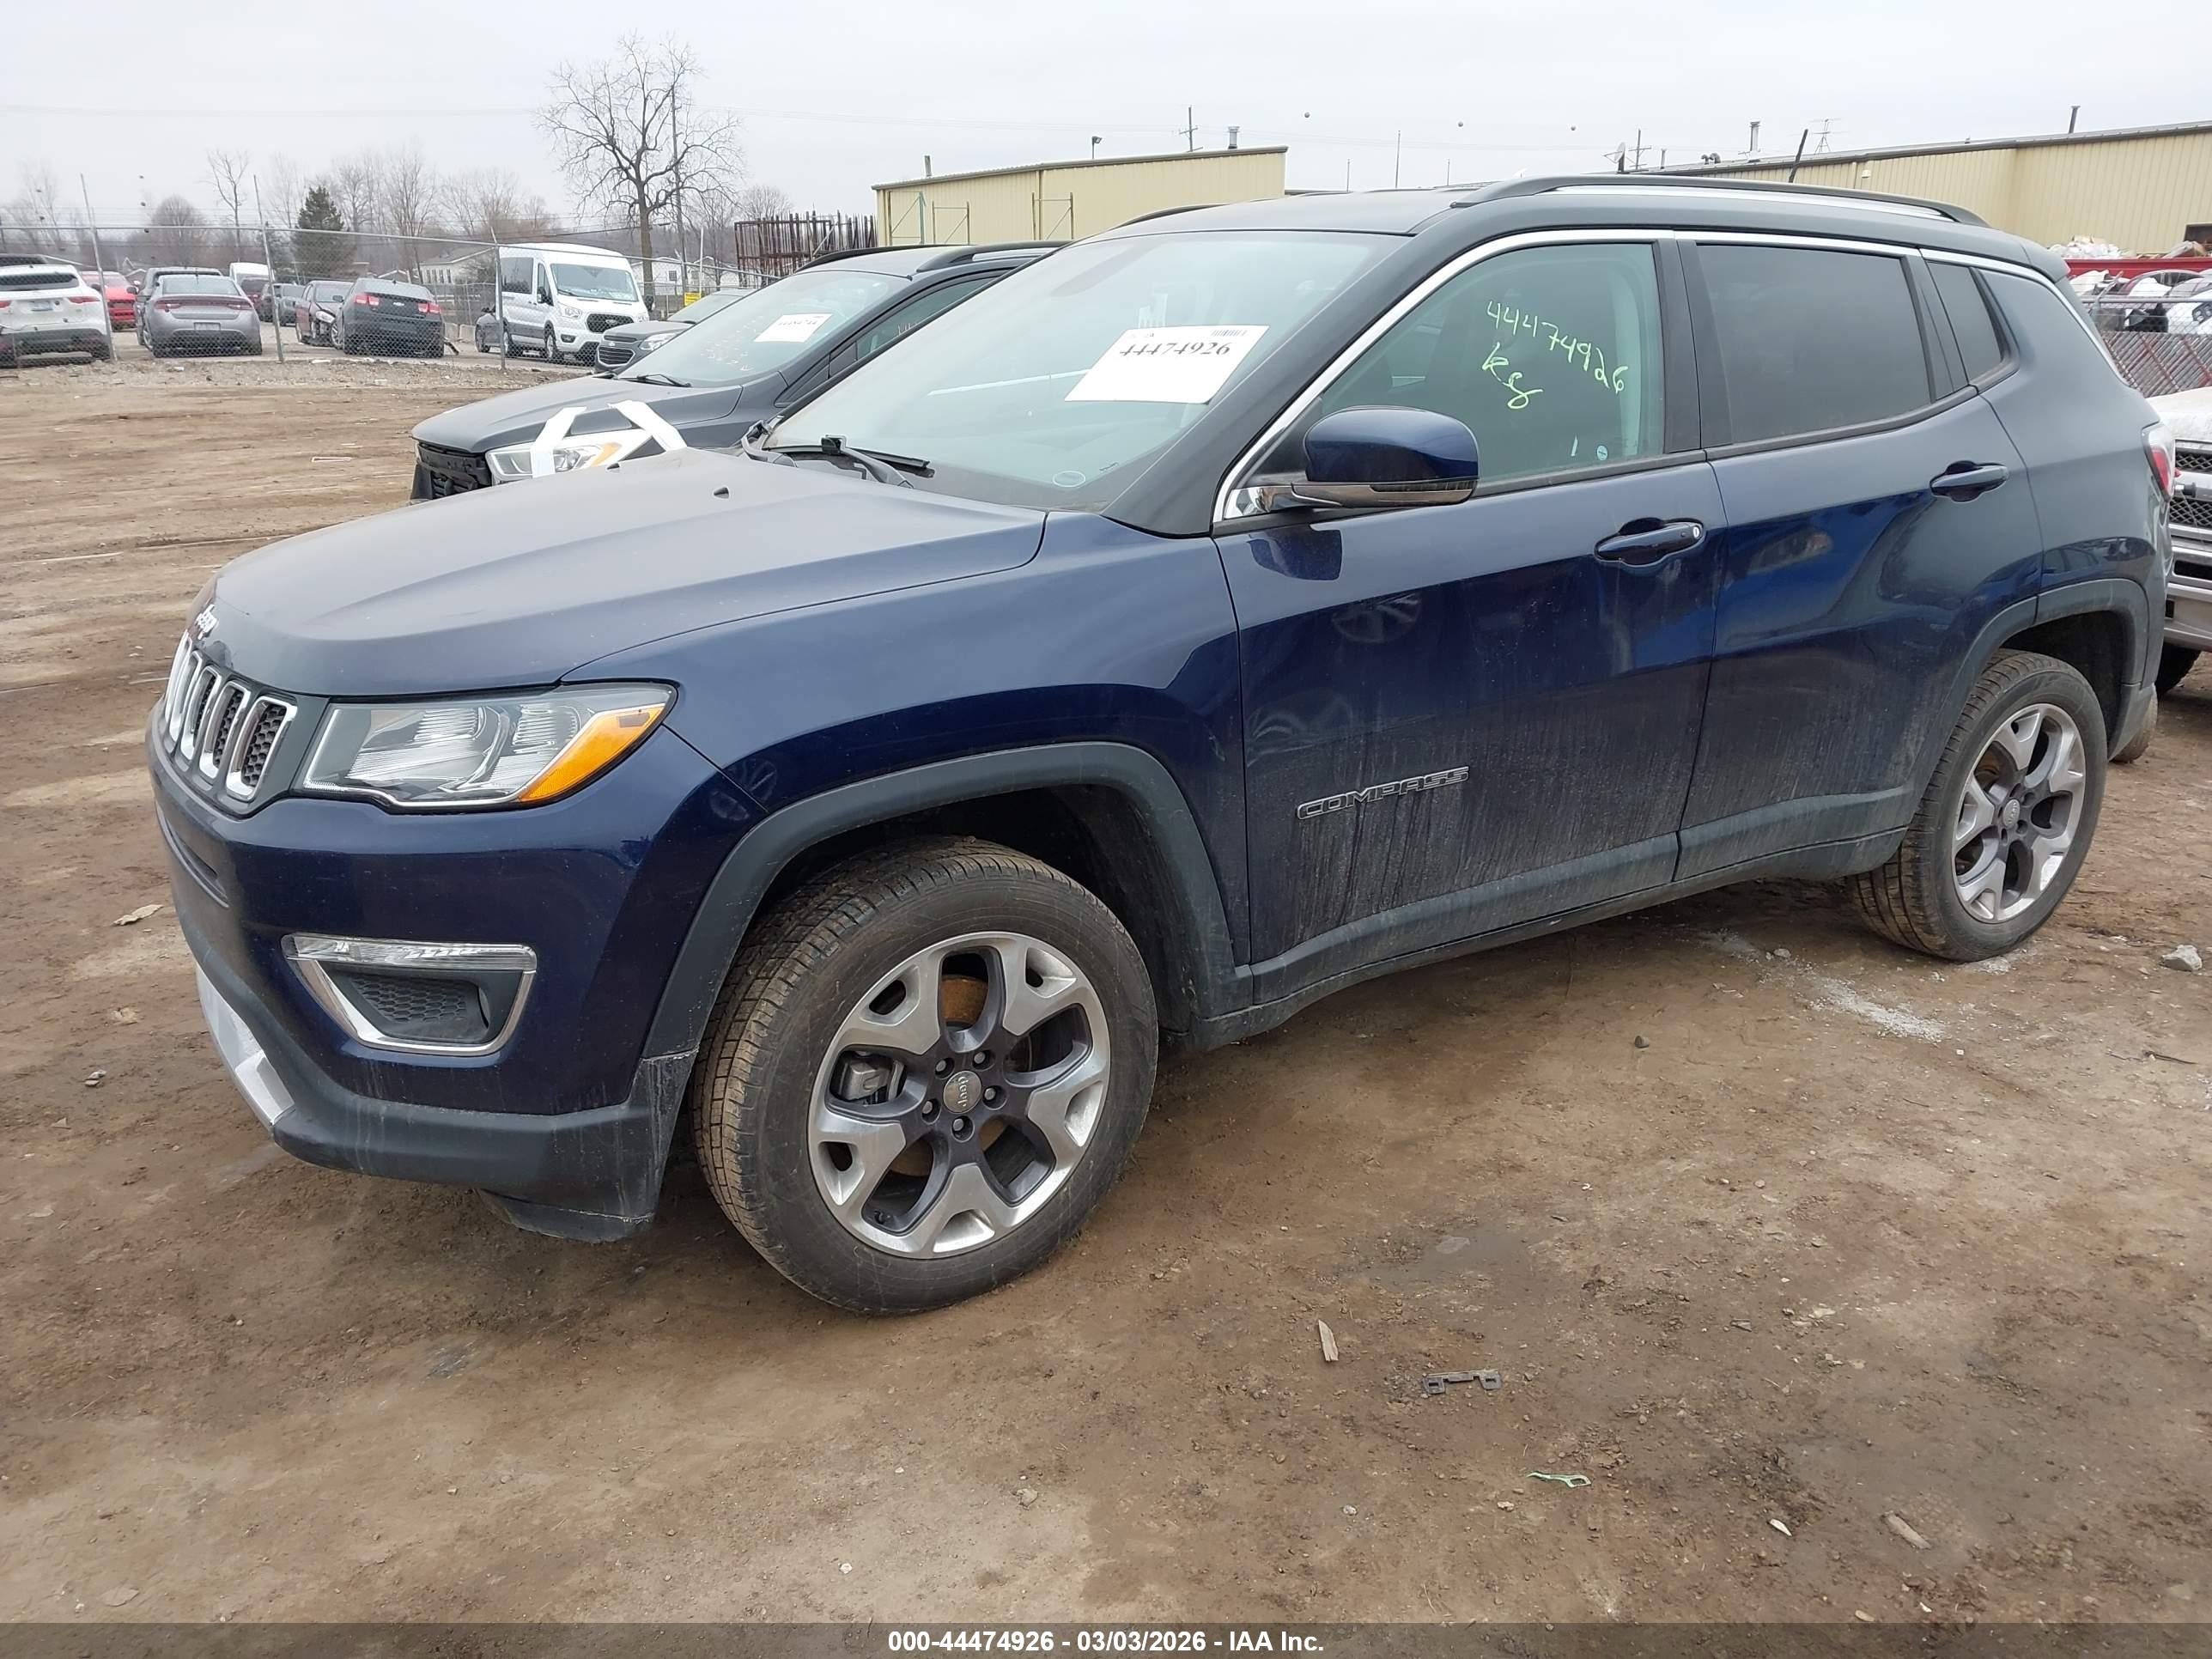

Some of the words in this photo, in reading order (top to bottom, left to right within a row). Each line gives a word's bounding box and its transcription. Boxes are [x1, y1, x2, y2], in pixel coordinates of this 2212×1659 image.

[1120, 342, 1231, 356] 44474926
[1486, 301, 1629, 394] 44474926
[1297, 765, 1470, 820] COMPASS
